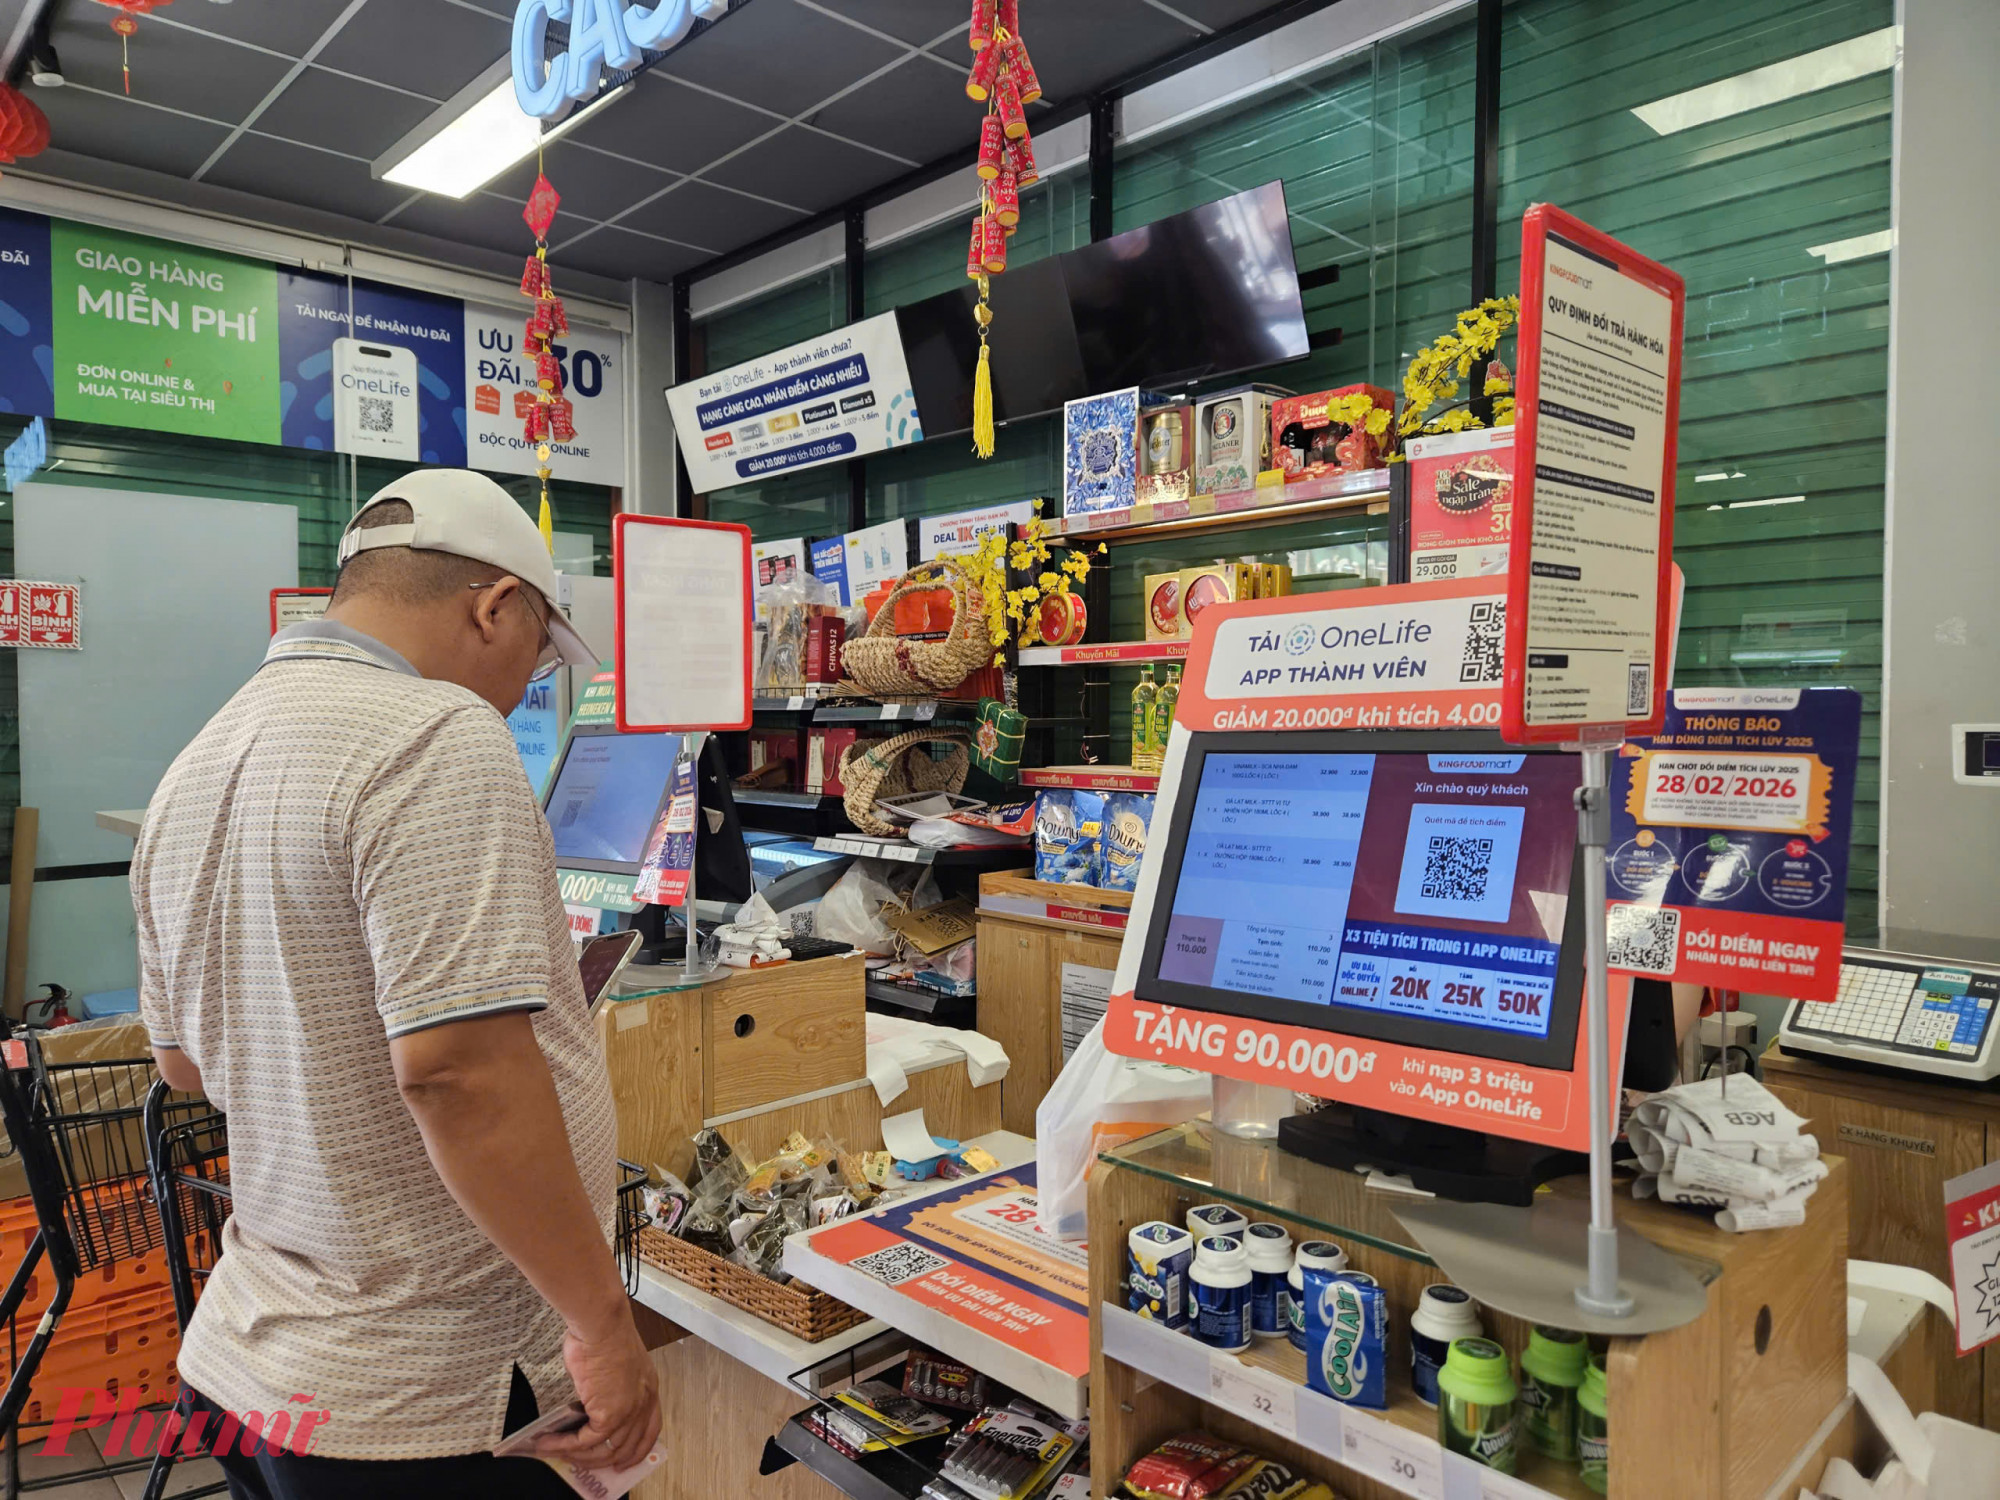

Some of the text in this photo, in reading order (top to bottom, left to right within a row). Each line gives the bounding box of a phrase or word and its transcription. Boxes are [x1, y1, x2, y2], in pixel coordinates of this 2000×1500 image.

[76, 248, 224, 292] GIAO HÀNG
[78, 282, 258, 343] MIỄN PHÍ
[295, 303, 450, 342] TẢI NGAY ĐỂ NHẬN ƯU ĐÃI
[1548, 295, 1664, 356] QUY ĐỊNH ĐỔI TRẢ HÀNG HÓA
[479, 328, 513, 353] ƯU
[478, 357, 520, 385] ĐÃI
[732, 366, 764, 387] OneLife
[774, 361, 789, 374] App
[790, 352, 812, 368] thành
[813, 347, 829, 360] viên
[831, 337, 852, 354] chưa?
[77, 363, 195, 392] ĐƠN ONLINE &
[341, 374, 410, 397] OneLife
[78, 382, 216, 414] MUA TẠI SIÊU THỊ
[701, 408, 723, 425] HẠNG
[723, 401, 745, 418] CÀNG
[763, 387, 788, 406] NHÂN
[788, 378, 810, 397] ĐIỂM
[810, 373, 836, 391] CÀNG
[479, 432, 506, 448] ĐỘC
[550, 443, 590, 457] ONLINE
[1442, 487, 1494, 507] ngập tràn
[1453, 478, 1480, 495] Sale
[934, 531, 956, 544] DEAL
[1416, 563, 1457, 577] 29.000
[31, 613, 72, 628] BÌNH
[1248, 619, 1432, 652] TẢI OneLife
[829, 638, 837, 672] CHIVAS
[1075, 648, 1120, 660] Khuyến Mãi
[1239, 656, 1428, 686] APP THÀNH VIÊN
[1754, 695, 1793, 704] OneLife
[1213, 705, 1268, 729] GIẢM
[1271, 706, 1353, 728] 20.000đ
[1357, 706, 1391, 726] khi
[1396, 703, 1440, 725] tích
[1685, 714, 1781, 731] THÔNG BÁO
[1736, 734, 1759, 746] TÍCH
[1784, 737, 1814, 747] 2025
[1438, 760, 1512, 769] KINGFOODmart
[1414, 782, 1529, 796] Xin chào quý khách
[1656, 773, 1797, 798] 28/02/2026
[1036, 816, 1080, 844] Downy
[1424, 816, 1443, 824] Quét
[1444, 817, 1457, 825] mã
[1469, 818, 1484, 826] tích
[1486, 819, 1506, 827] điểm
[1176, 943, 1207, 954] 110.000
[1307, 945, 1331, 953] 110.700
[1345, 929, 1555, 966] X3 TIỆN TÍCH TRONG 1 APP ONELIFE
[1685, 928, 1820, 961] ĐỔI ĐIỂM NGAY
[1301, 978, 1325, 987] 110.000
[1390, 975, 1431, 1000] 20K
[1442, 982, 1485, 1008] 25K
[1974, 981, 1997, 989] CAS
[1498, 989, 1543, 1016] 50K
[1132, 1003, 1377, 1084] TẶNG 90.000đ
[1402, 1056, 1534, 1096] khi nạp 3 triệu
[1389, 1078, 1543, 1121] vào App OneLife
[1724, 1111, 1776, 1126] ACB
[1839, 1125, 1936, 1154] CK HÀNG KHUYẾN
[929, 1271, 1053, 1327] ĐỔI ĐIỂM NGAY
[1253, 1393, 1273, 1415] 32
[983, 1425, 1048, 1449] Energizer
[1390, 1455, 1416, 1479] 30
